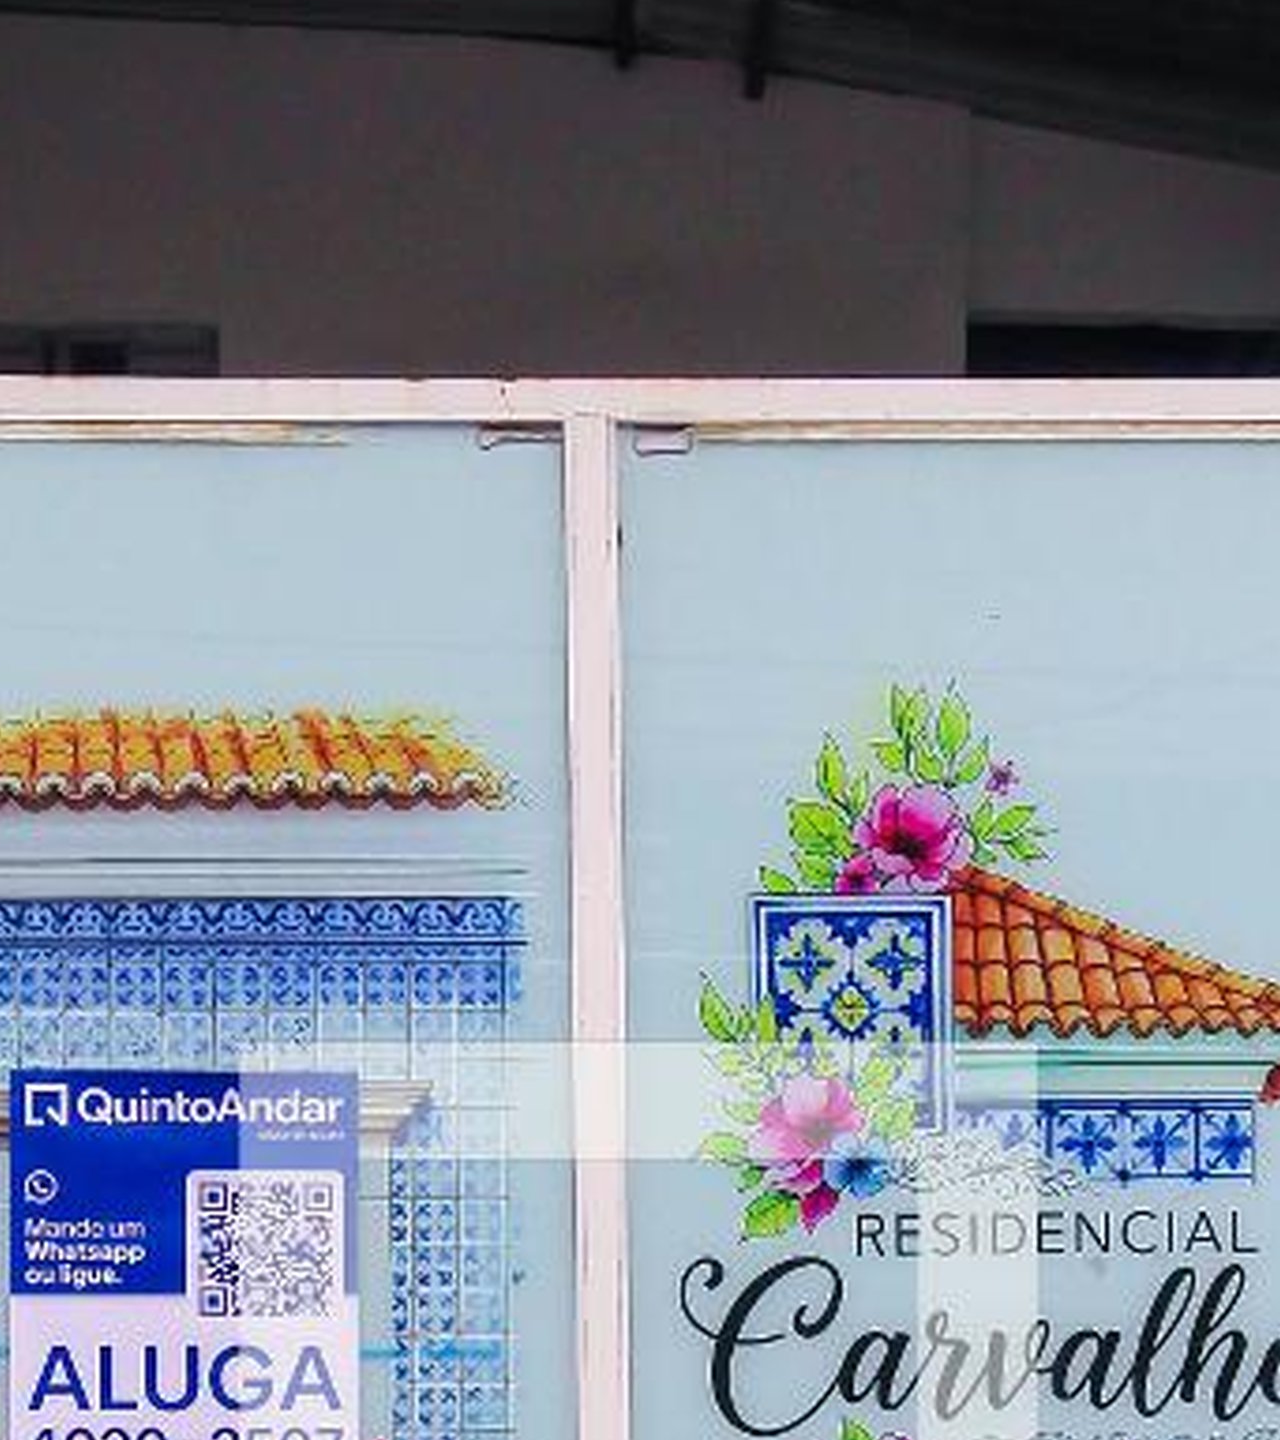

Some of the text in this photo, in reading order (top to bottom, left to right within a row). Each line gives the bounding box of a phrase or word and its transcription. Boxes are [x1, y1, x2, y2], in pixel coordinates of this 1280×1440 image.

[76, 1086, 344, 1127] QuintoAndar
[24, 1218, 105, 1239] Mande
[854, 1210, 1260, 1257] RESIDENCIAL
[28, 1346, 342, 1411] ALUGA
